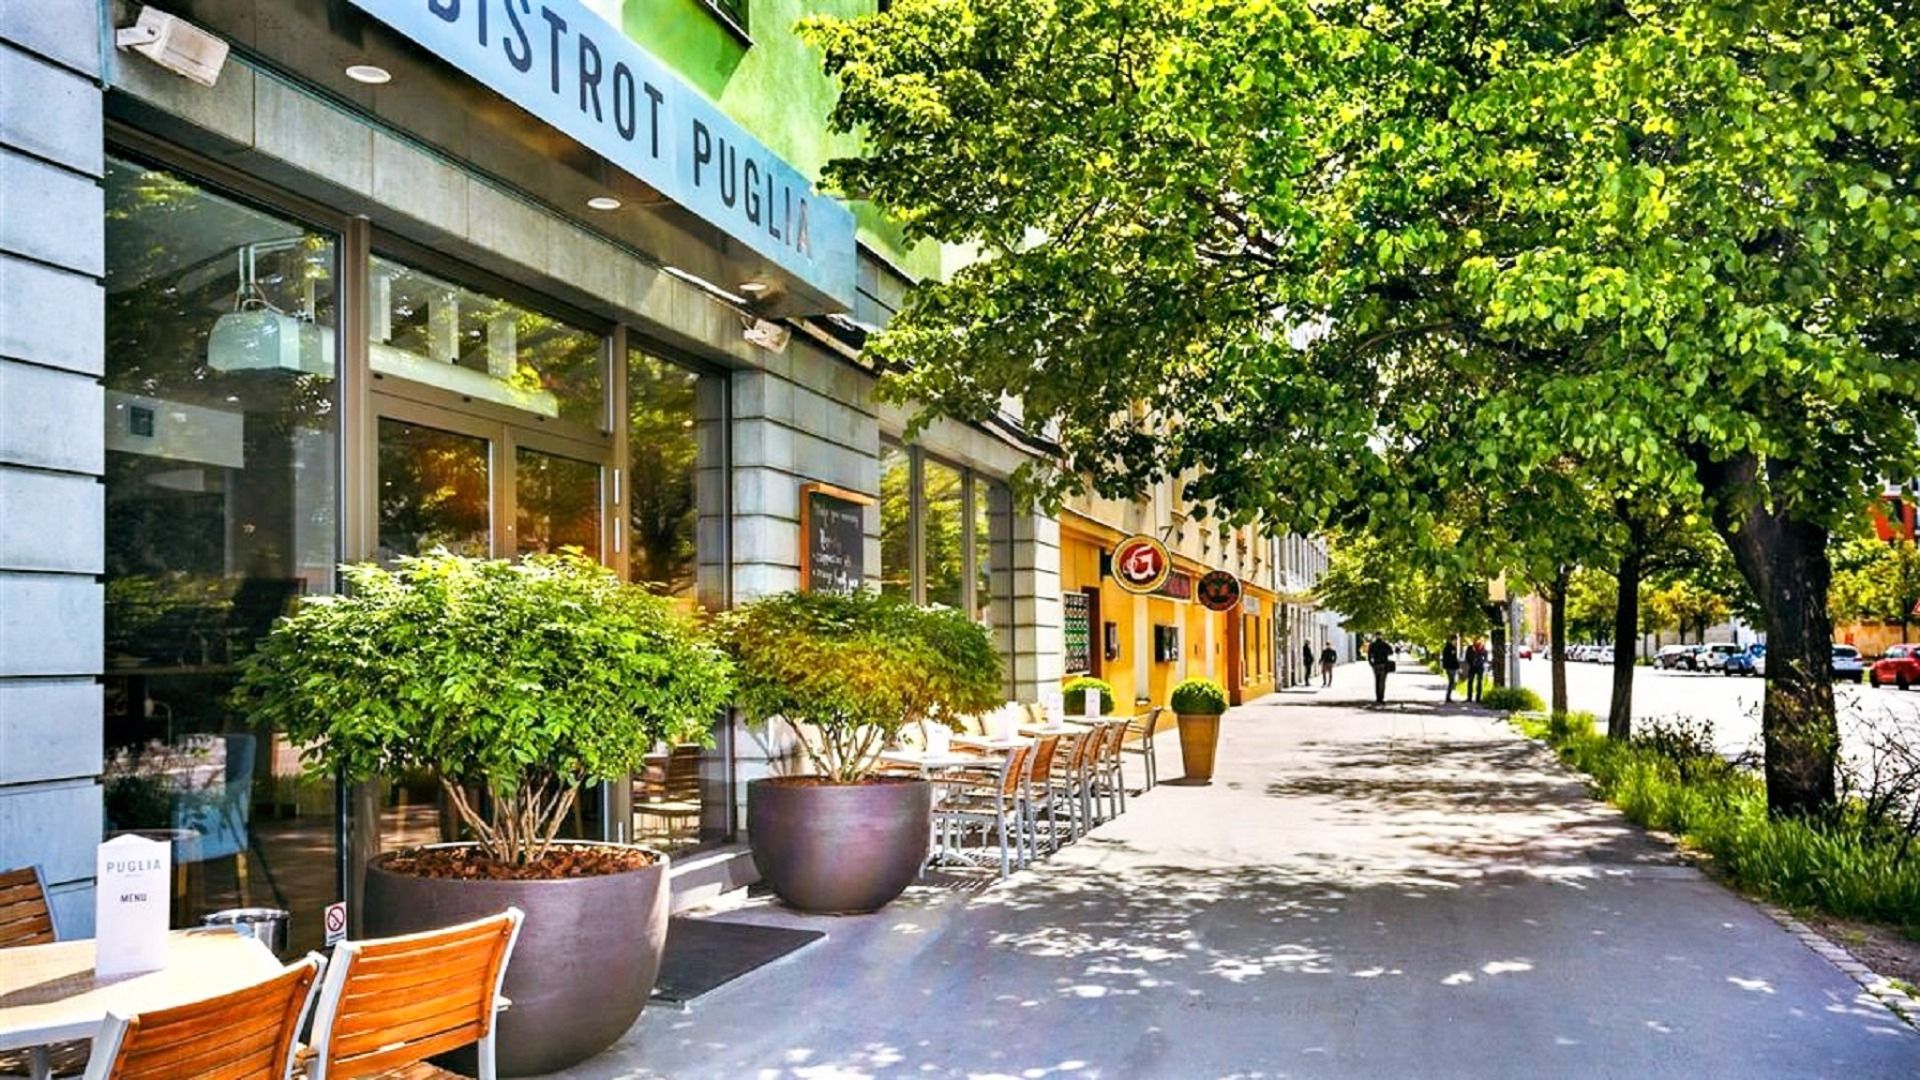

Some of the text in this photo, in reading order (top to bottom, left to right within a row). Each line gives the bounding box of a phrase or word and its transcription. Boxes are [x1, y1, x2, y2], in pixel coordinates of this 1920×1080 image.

[428, 0, 812, 259] ISTROT PUGLIA
[106, 859, 162, 873] PUGLIA
[120, 893, 148, 903] MENU
